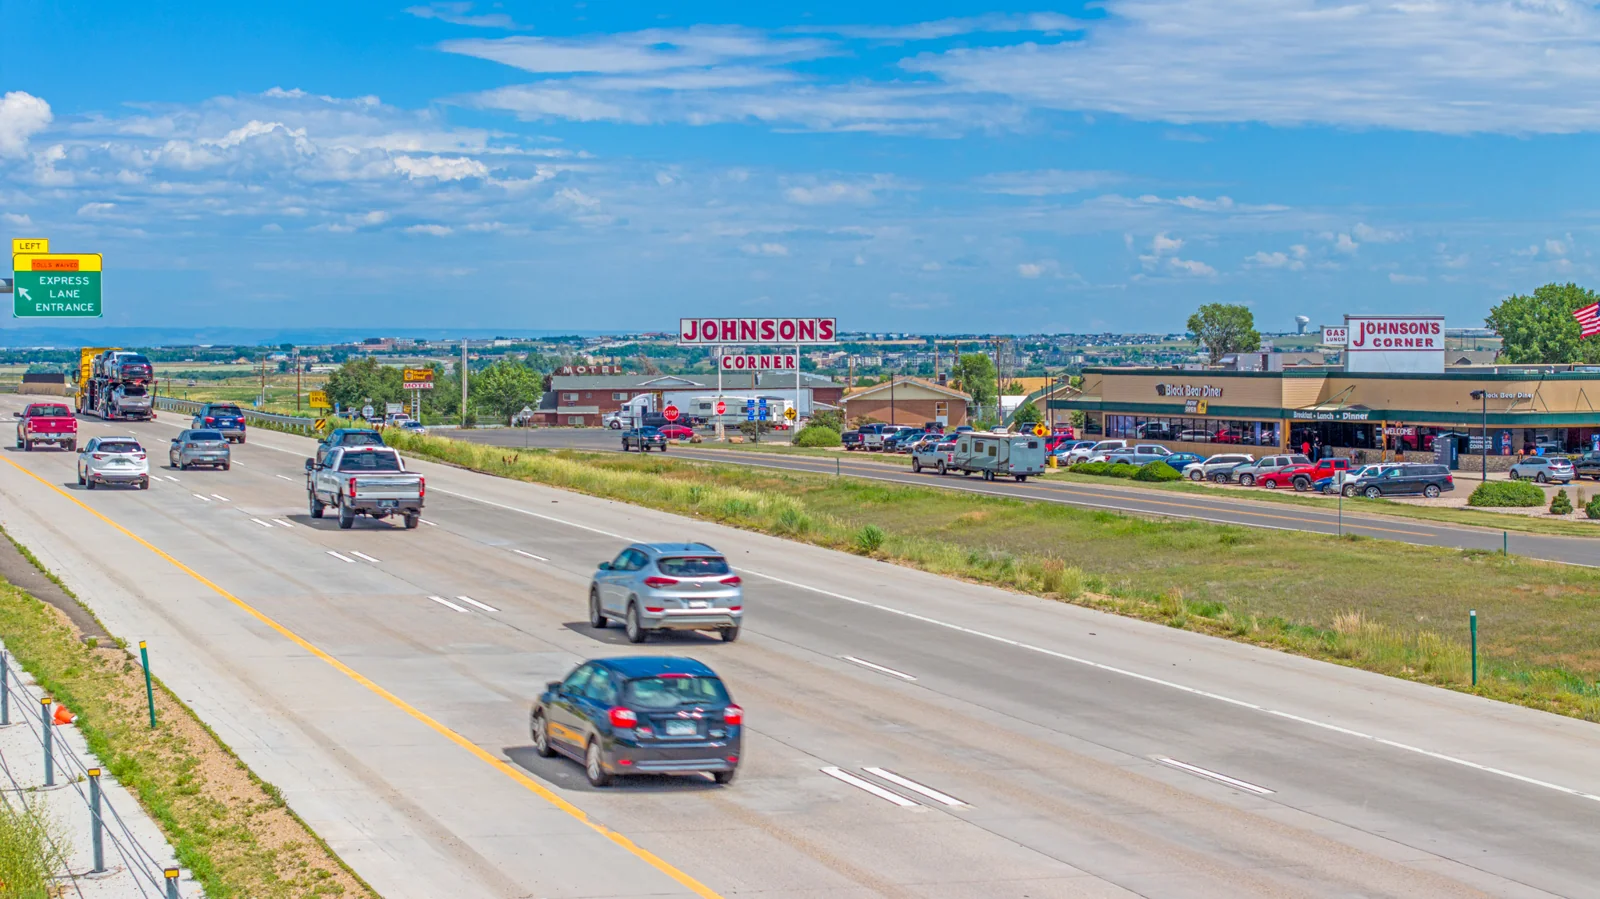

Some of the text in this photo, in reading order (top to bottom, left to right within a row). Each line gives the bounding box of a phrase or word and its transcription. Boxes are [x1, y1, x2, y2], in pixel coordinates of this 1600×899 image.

[39, 276, 90, 285] EXPRESS
[49, 290, 80, 298] LANE
[35, 303, 94, 311] ENTRANCE
[683, 318, 834, 341] JOHNSON'S
[1326, 329, 1345, 337] GAS
[1353, 321, 1440, 347] JOHNSON'S
[1373, 338, 1434, 347] CORNER
[722, 356, 795, 369] CORNER
[563, 365, 621, 374] MOTEL
[1166, 384, 1223, 397] Black Bear Diner
[1293, 411, 1313, 419] Breakfast
[1343, 412, 1369, 420] Dinner
[1384, 427, 1413, 436] WELCOME
